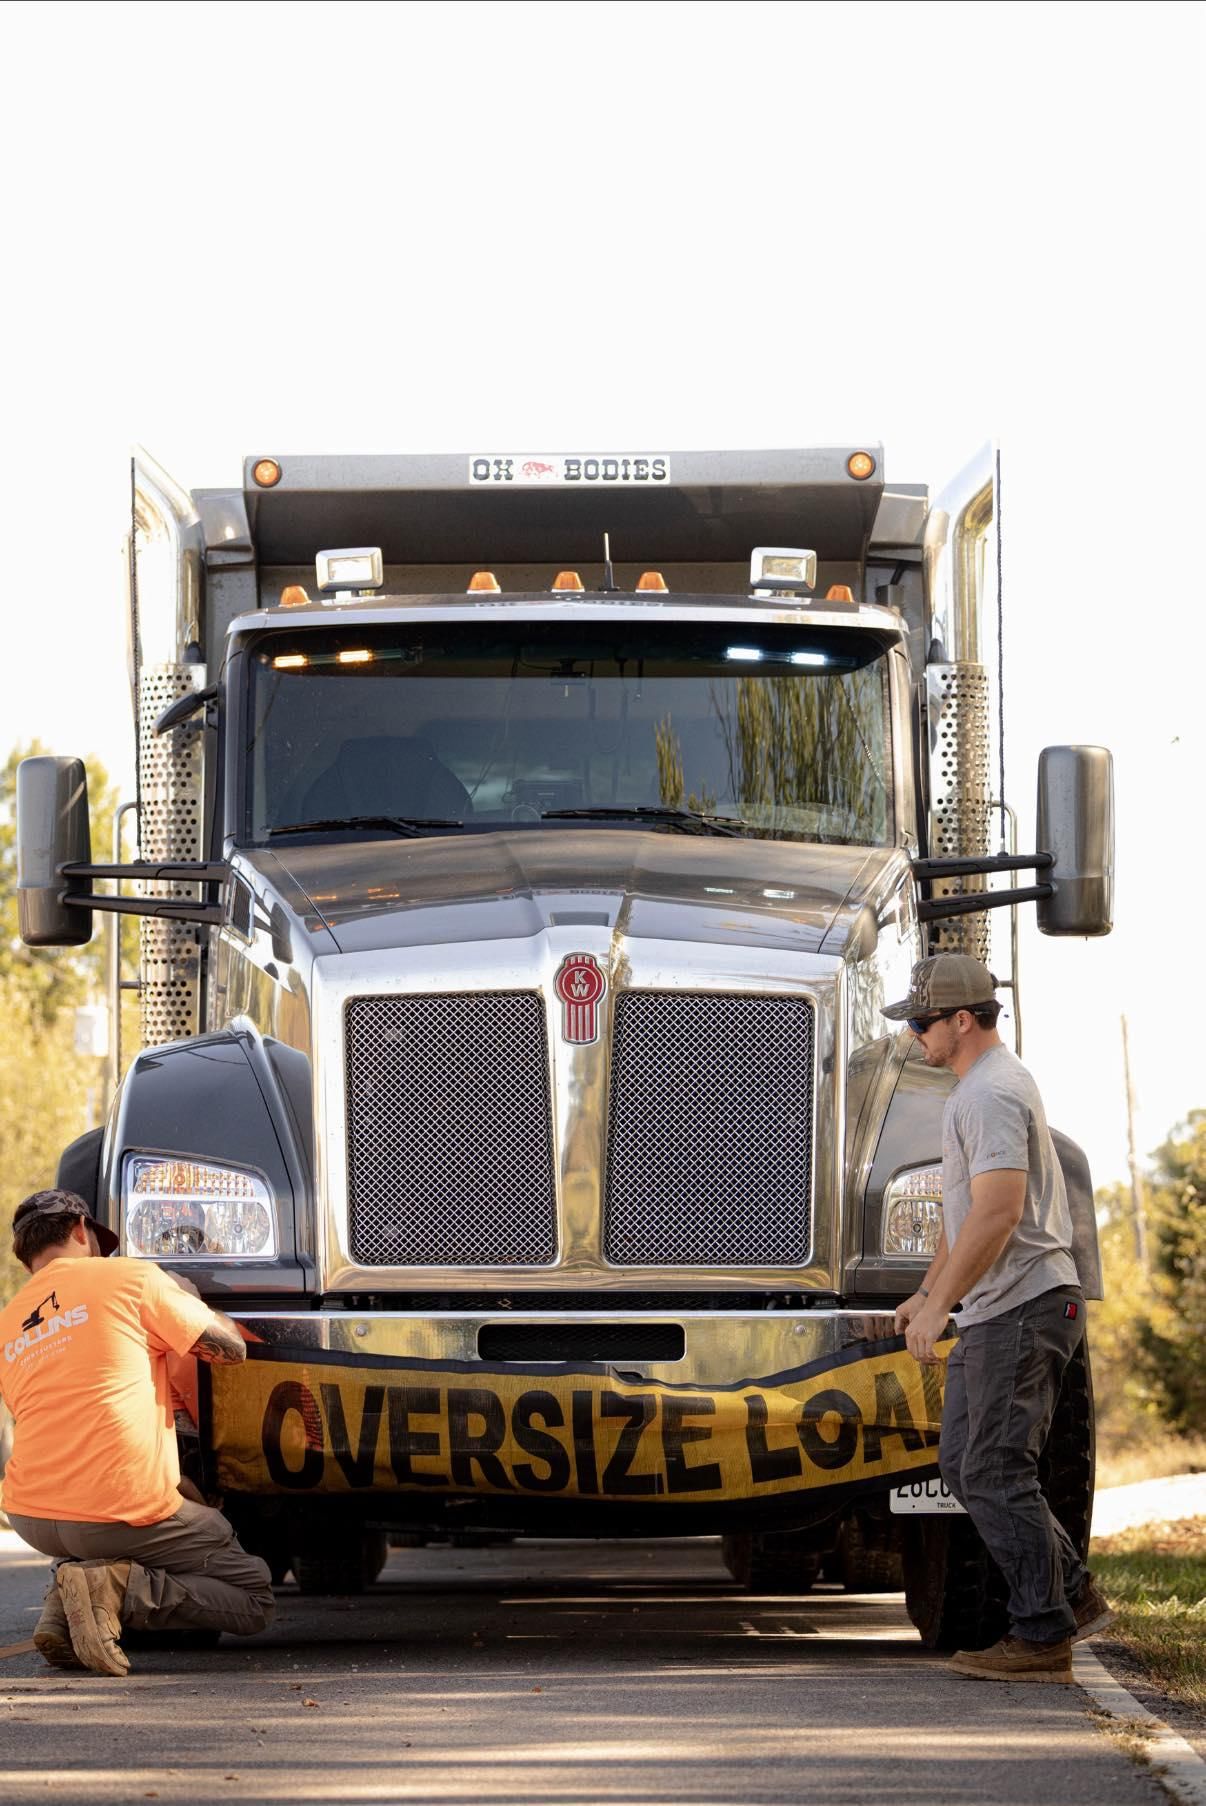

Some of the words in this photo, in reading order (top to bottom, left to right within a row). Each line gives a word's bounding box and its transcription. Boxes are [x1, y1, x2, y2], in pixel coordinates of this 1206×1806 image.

[472, 459, 514, 481] OX
[564, 459, 666, 481] BODIES
[4, 1304, 89, 1363] COLLINS
[261, 1380, 723, 1495] OVERSIZE
